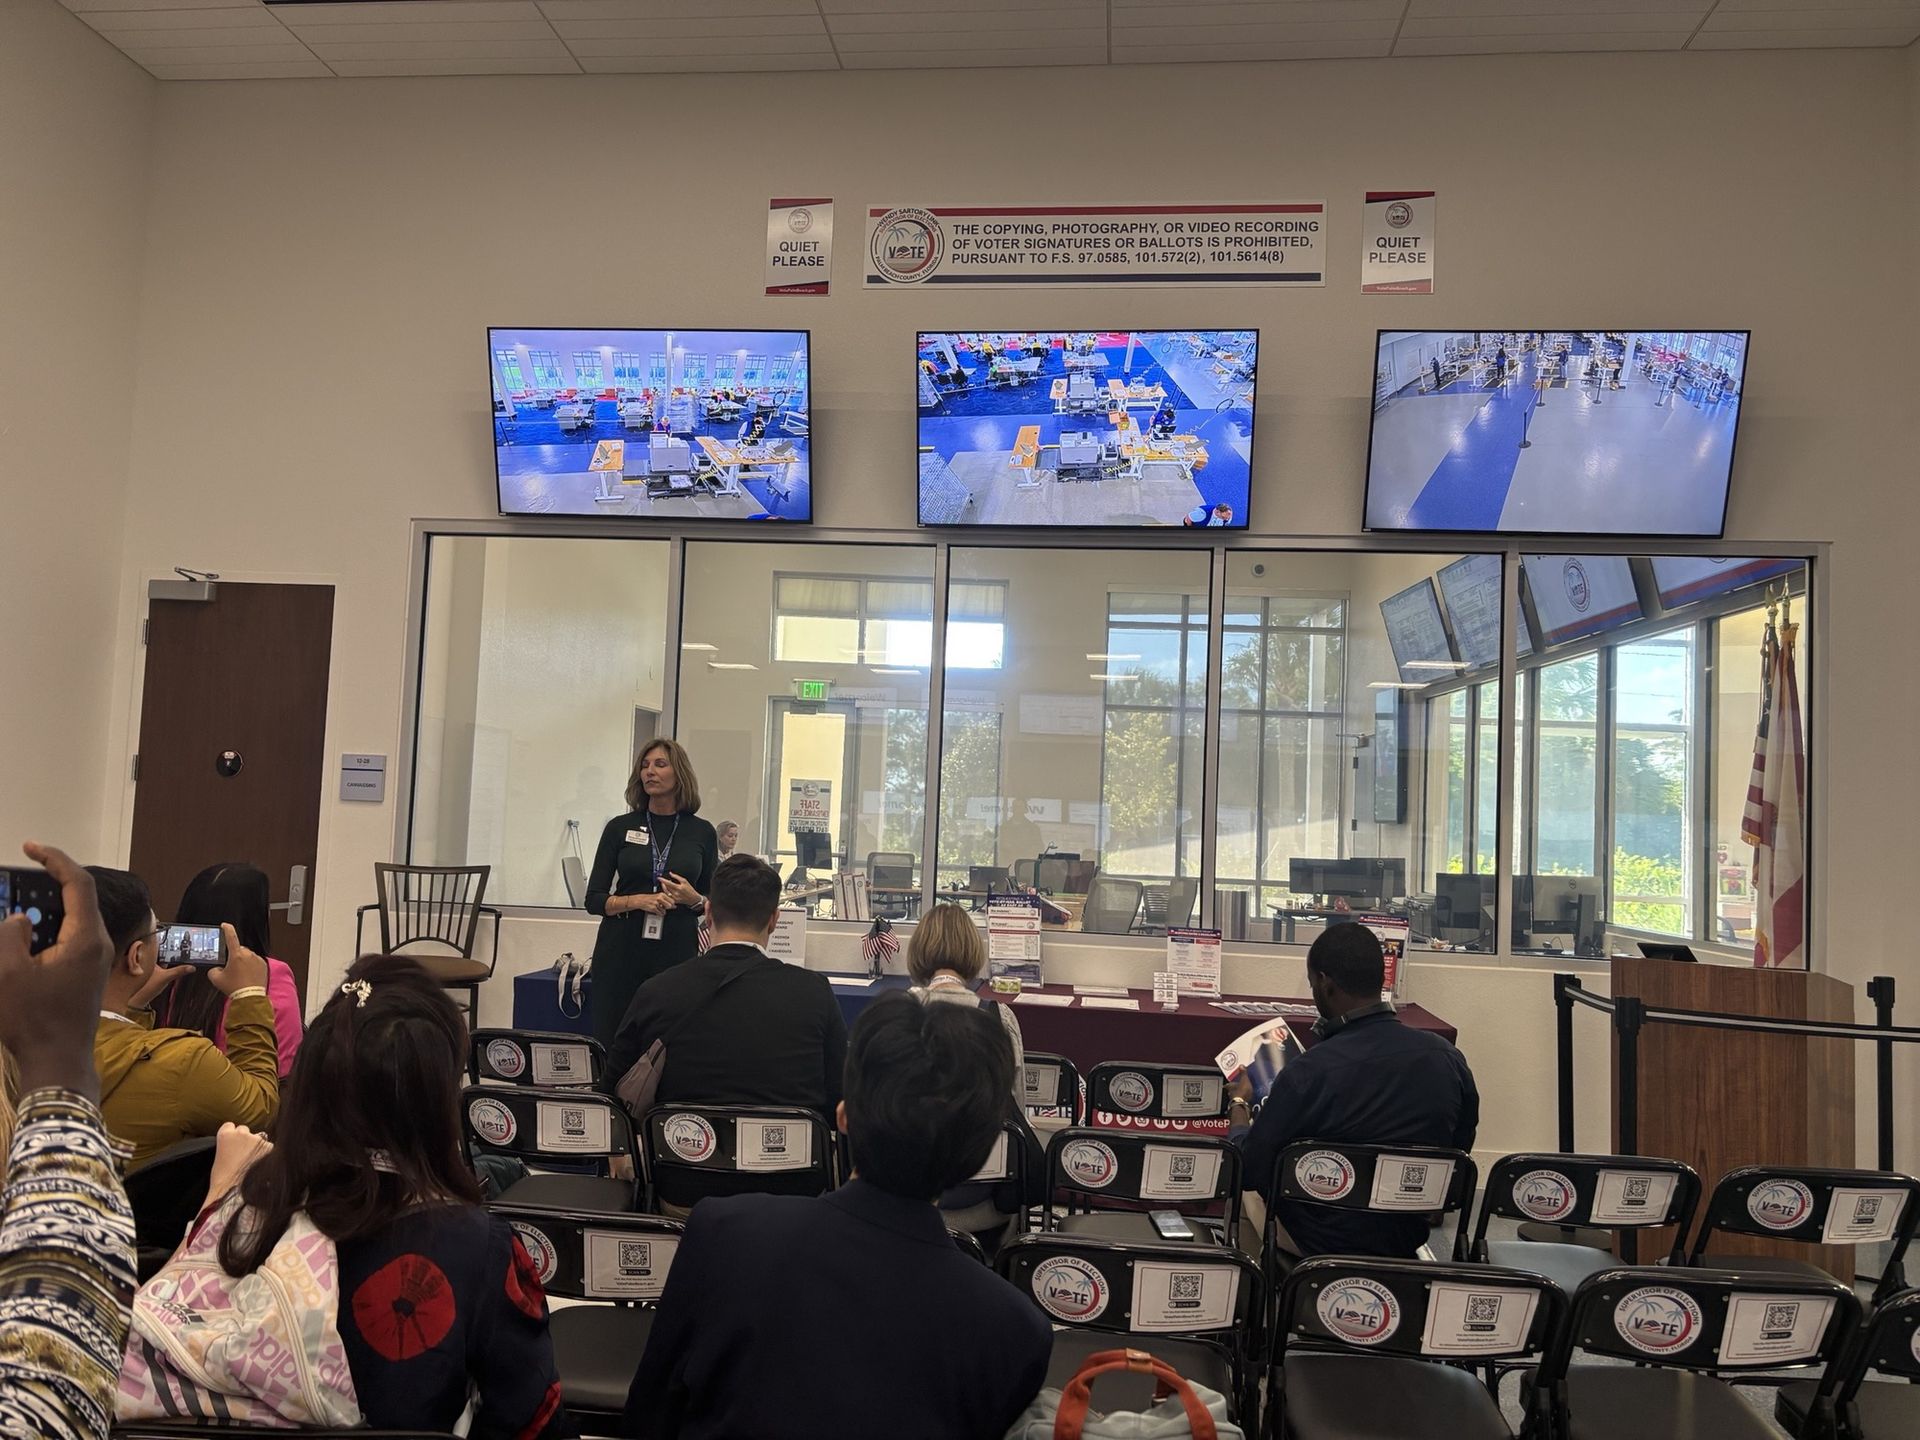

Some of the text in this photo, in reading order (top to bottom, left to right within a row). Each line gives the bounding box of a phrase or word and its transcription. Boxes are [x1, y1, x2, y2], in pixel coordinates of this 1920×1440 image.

[877, 208, 939, 227] WENDY SARTORY LINK
[953, 221, 1319, 236] THE COPYING, PHOTOGRAPHY, OR VIDEO RECORDING
[779, 241, 820, 252] QUIET
[953, 236, 1313, 249] OF VOTER SIGNATURES OR BALLOTS IS PROHIBITED,
[1376, 237, 1421, 248] QUIET
[772, 256, 825, 267] PLEASE
[952, 251, 1285, 265] PURSUANT TO F.S. 97.0585, 101.572(2), 101.5614(8)
[1369, 252, 1426, 263] PLEASE
[803, 682, 824, 698] EXIT
[1192, 1119, 1231, 1129] @VoteP
[530, 1228, 555, 1260] ELECTIONS
[1035, 1258, 1069, 1280] SUPERVISOR
[1081, 1263, 1107, 1295] ELECTIONS
[1321, 1279, 1360, 1301] SUPERVISOR
[1374, 1285, 1397, 1318] ELECTIONS
[1619, 1288, 1662, 1312] SUPERVISOR
[1675, 1291, 1699, 1326] ELECTIONS
